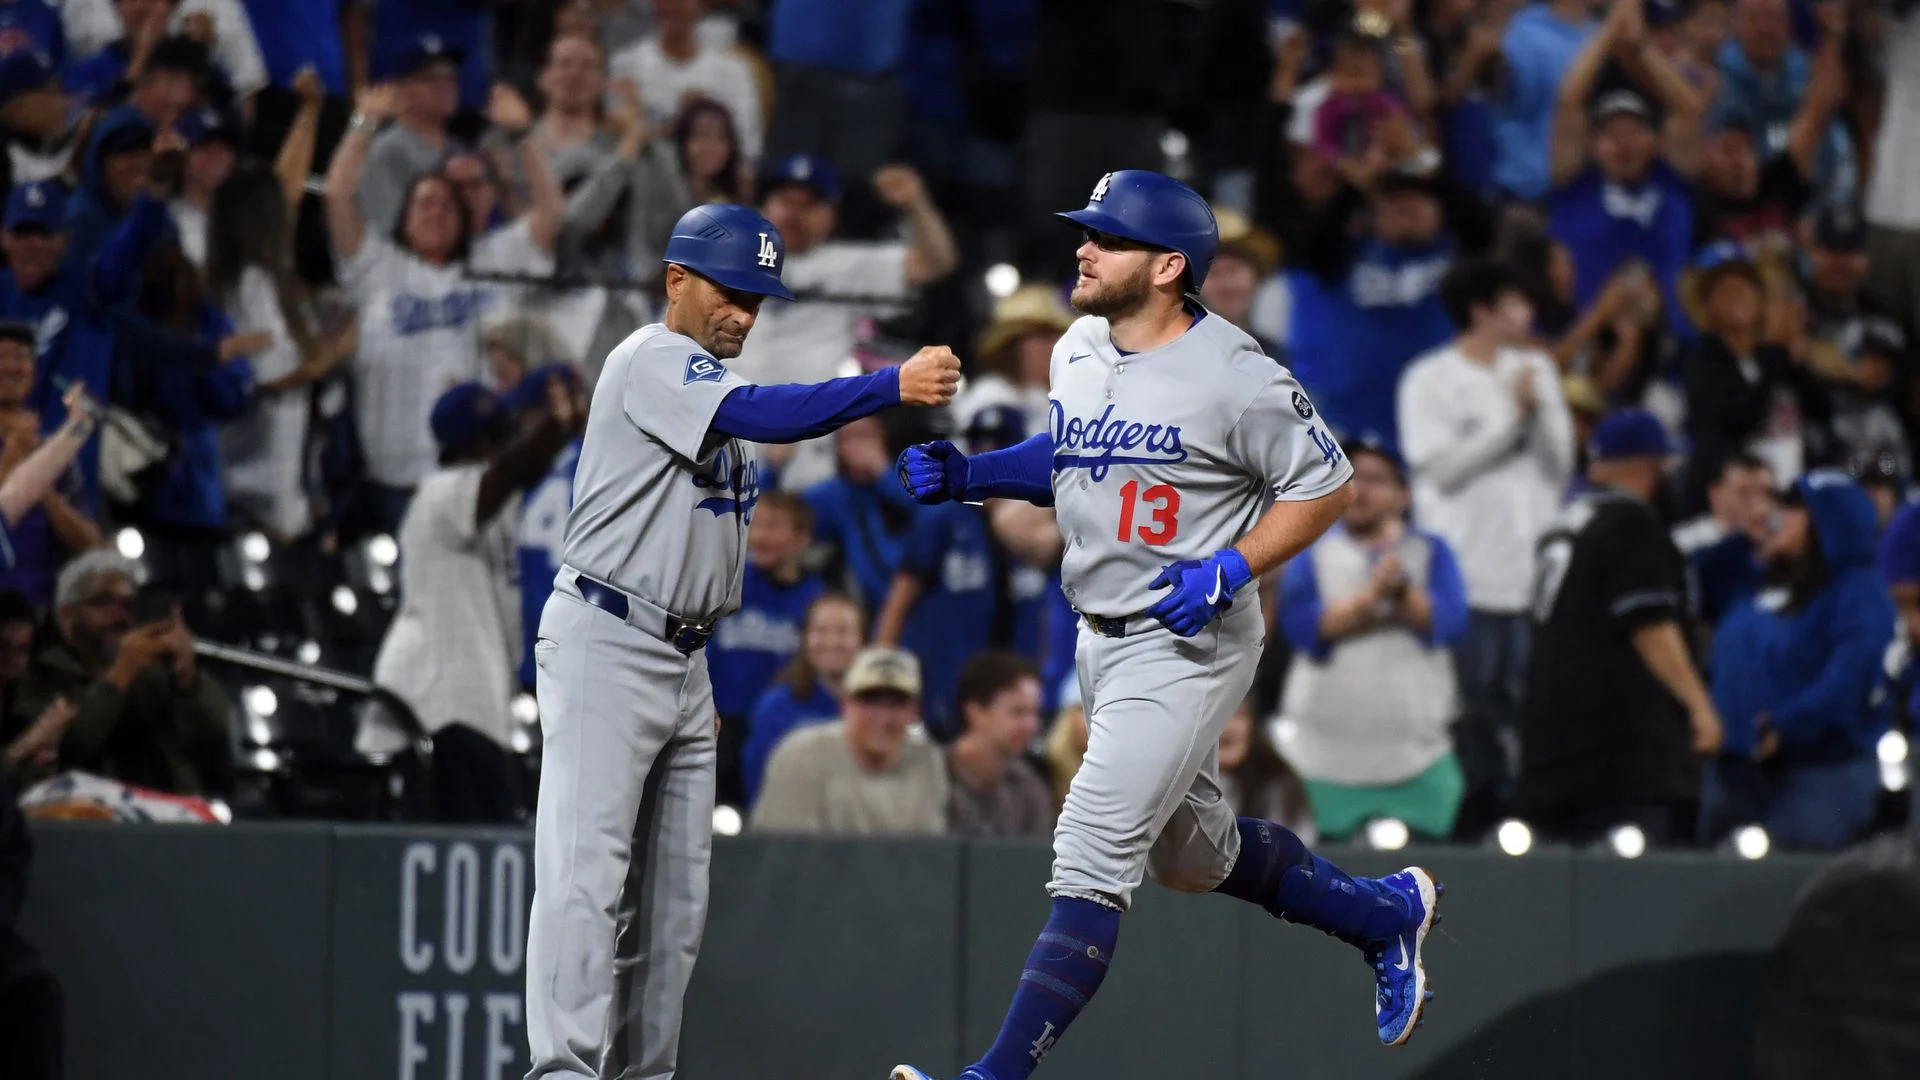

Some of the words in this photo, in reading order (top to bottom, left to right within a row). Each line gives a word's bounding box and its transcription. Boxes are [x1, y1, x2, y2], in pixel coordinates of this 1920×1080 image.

[757, 232, 777, 268] LA
[1048, 399, 1187, 483] Dodgers
[1306, 425, 1342, 470] LA
[1117, 479, 1181, 546] 13
